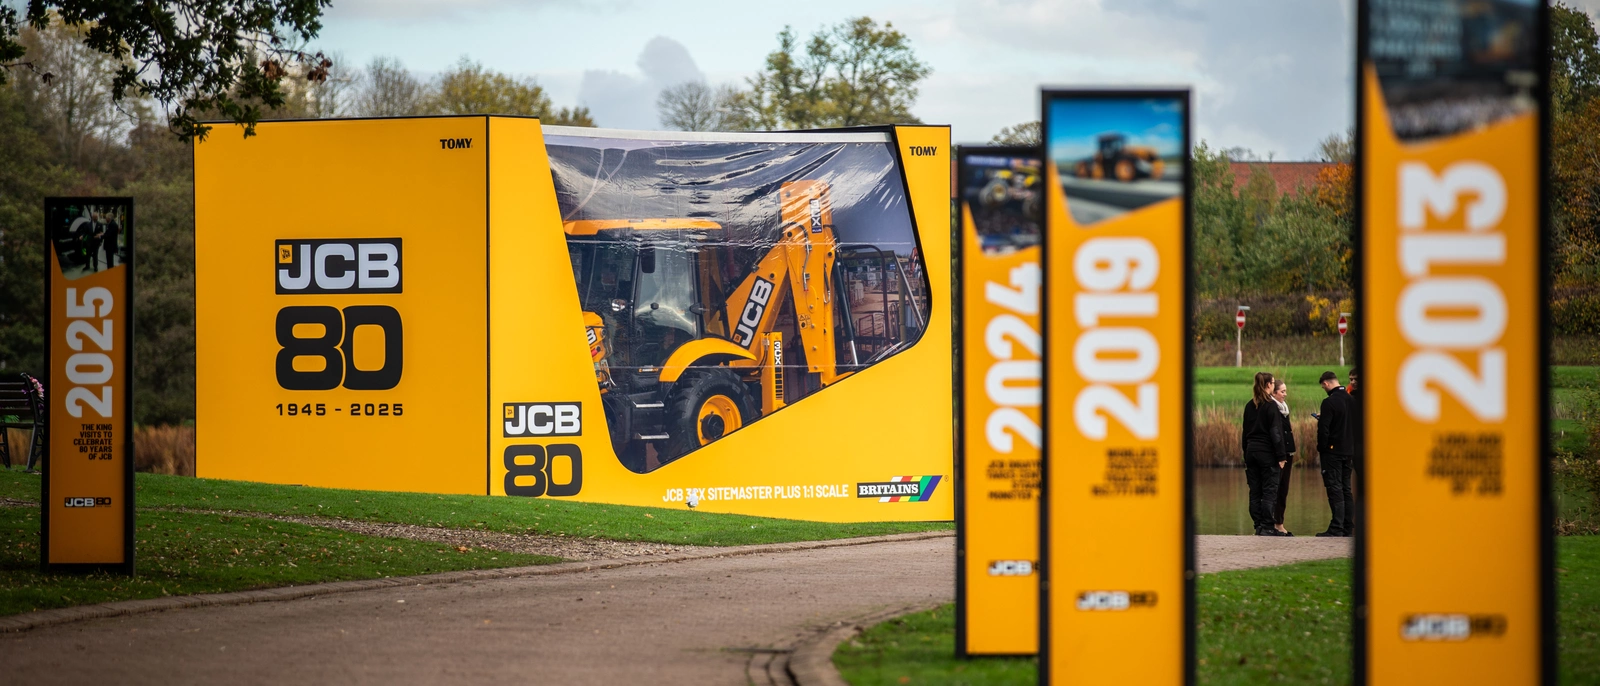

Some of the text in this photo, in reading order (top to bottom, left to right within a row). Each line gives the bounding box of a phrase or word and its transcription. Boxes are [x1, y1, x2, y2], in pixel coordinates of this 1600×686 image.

[440, 138, 472, 149] TOMY
[909, 145, 937, 156] TOMY
[278, 243, 400, 290] JCB
[1398, 160, 1508, 422] 2013
[739, 279, 772, 347] JCB
[65, 286, 114, 419] 2025
[275, 305, 403, 390] 80
[985, 262, 1043, 454] 2024
[1073, 236, 1160, 441] 2019
[276, 403, 327, 416] 1945
[350, 403, 404, 416] 2025
[505, 404, 580, 435] JCB
[73, 438, 112, 446] CELEBRATE
[503, 443, 582, 497] 80
[859, 483, 920, 496] BRITAINS
[65, 497, 112, 507] JCB 80
[662, 488, 684, 502] JCB
[707, 486, 773, 501] SITEMASTER
[774, 486, 801, 499] PLUS
[803, 485, 815, 499] 1:1
[815, 484, 849, 498] SCALE
